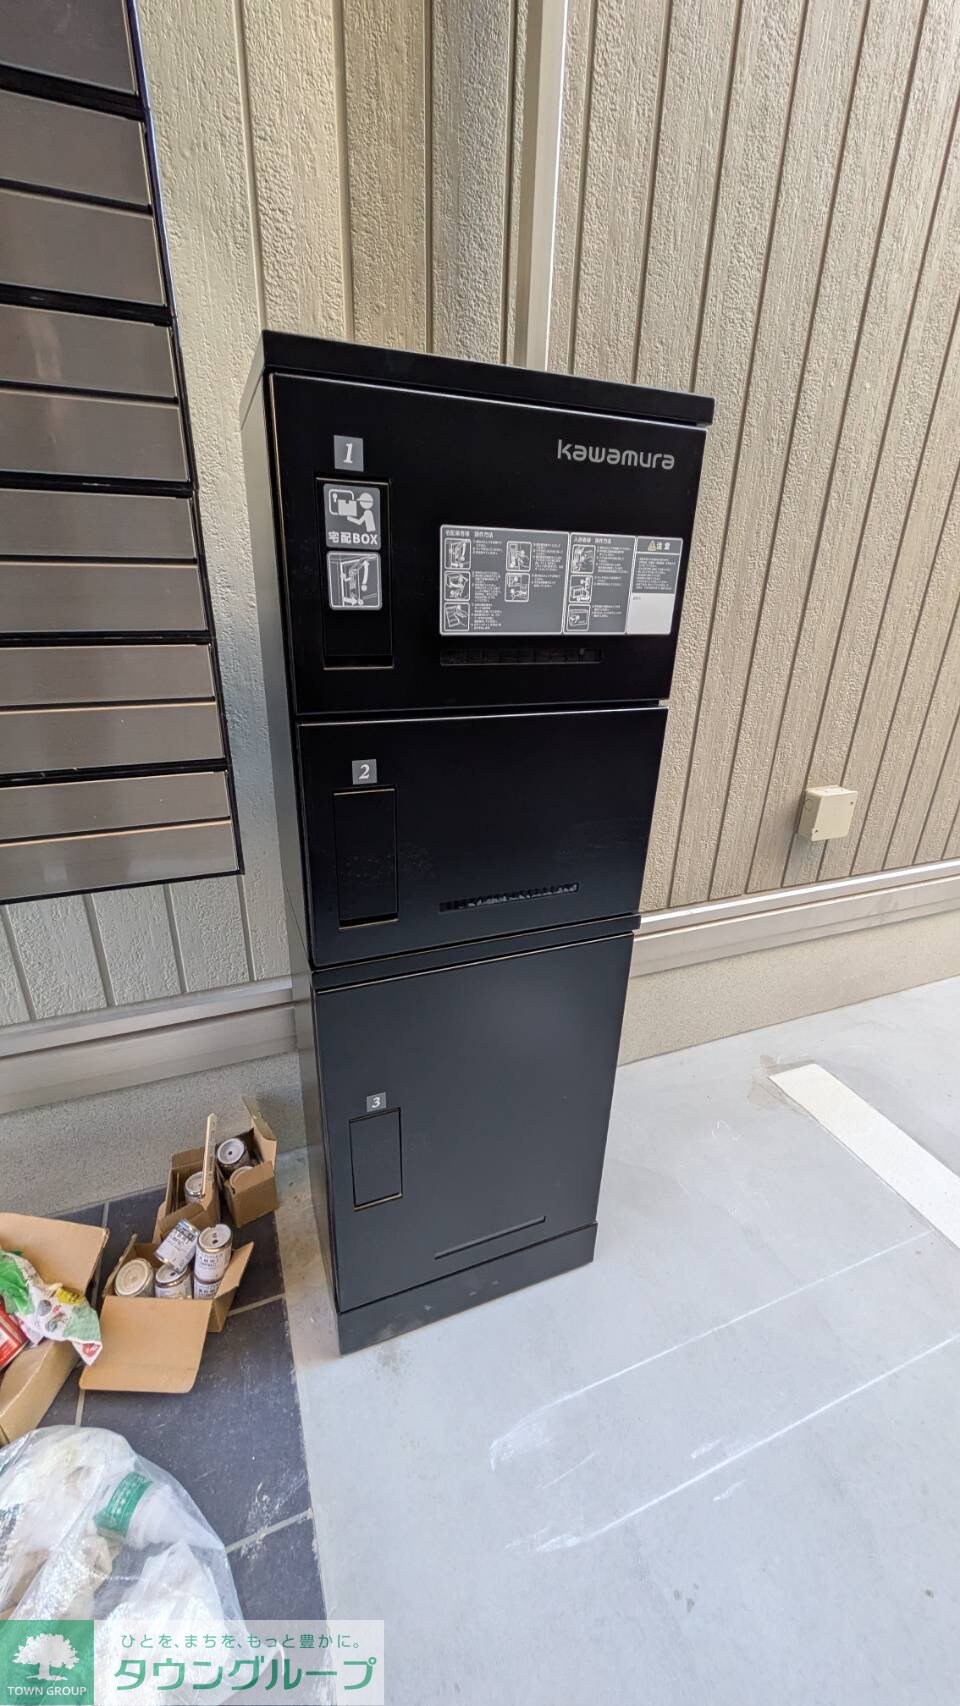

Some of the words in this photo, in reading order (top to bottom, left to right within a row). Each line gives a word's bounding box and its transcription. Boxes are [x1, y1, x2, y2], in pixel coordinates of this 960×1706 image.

[343, 443, 353, 464] 1
[557, 439, 675, 470] kawamura
[328, 531, 378, 545] 宅配BOX
[359, 764, 370, 780] 2
[371, 1096, 381, 1108] 3
